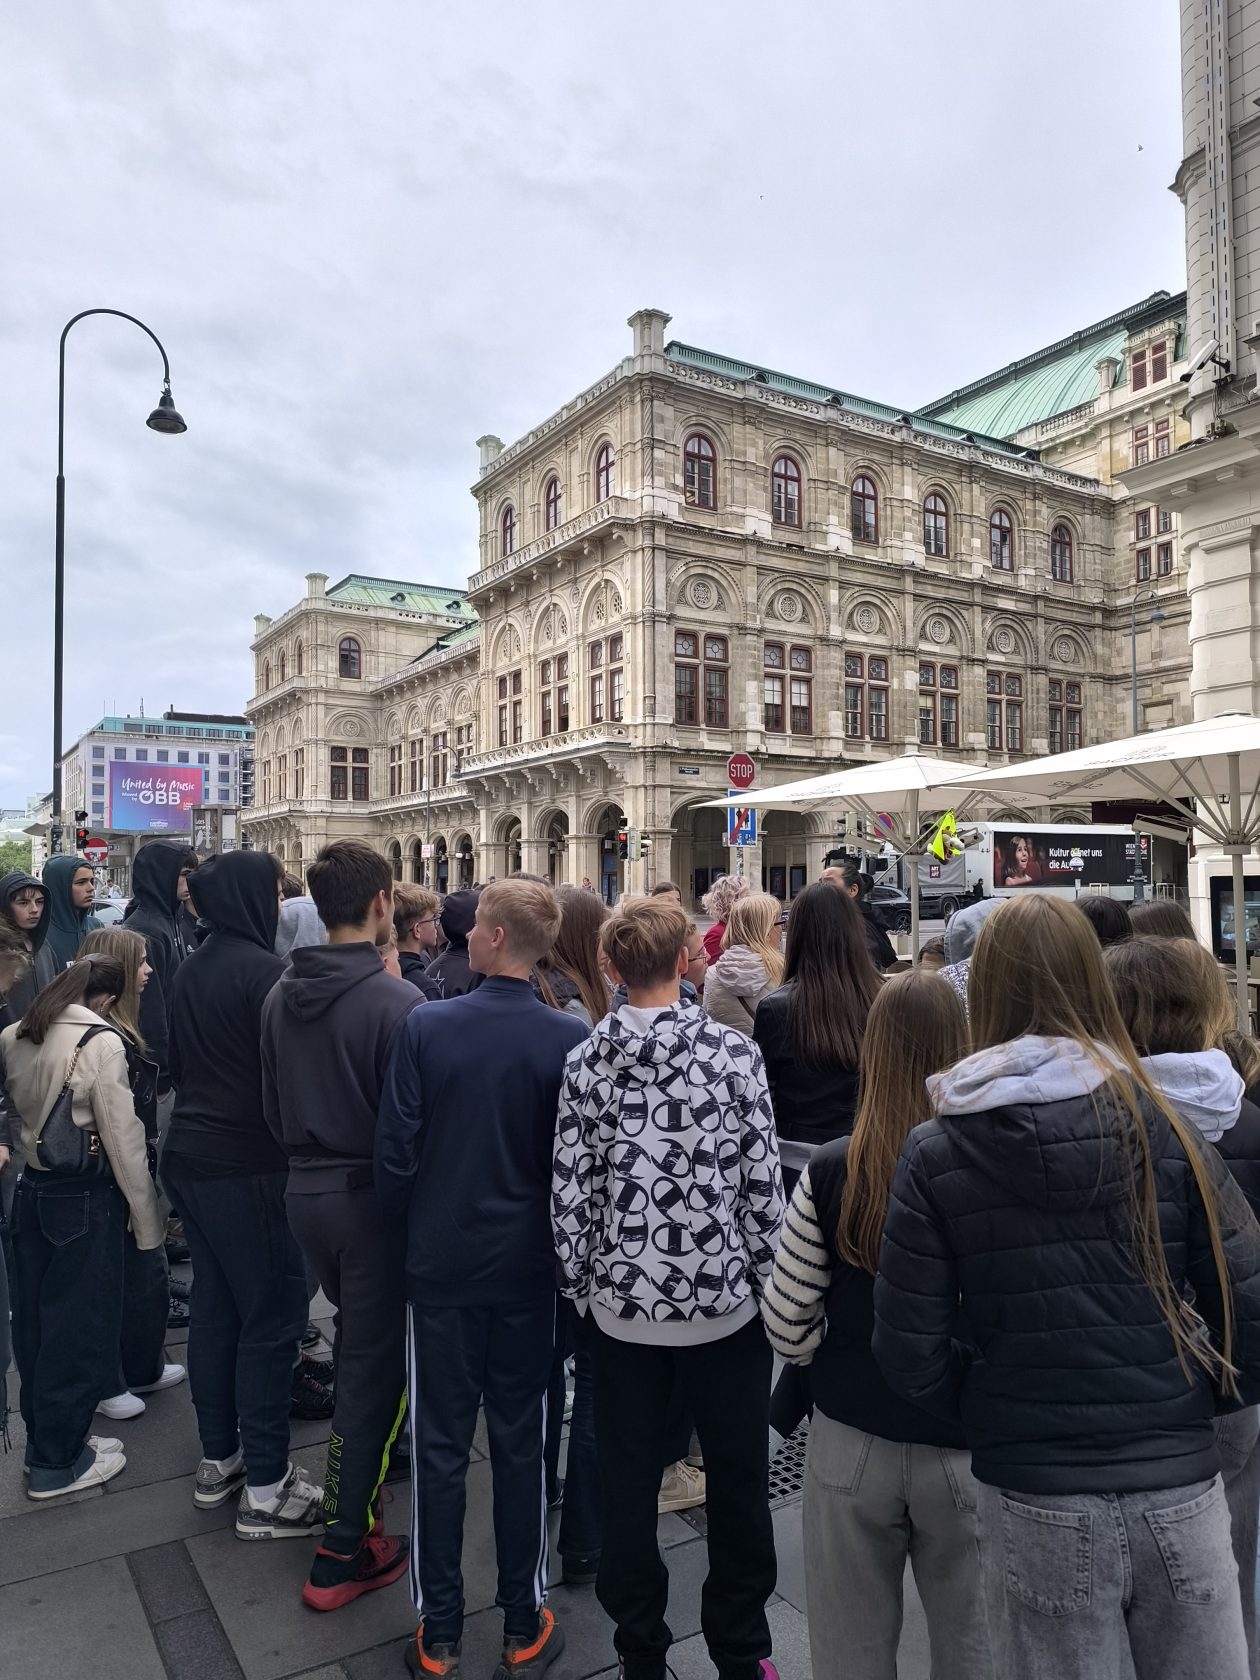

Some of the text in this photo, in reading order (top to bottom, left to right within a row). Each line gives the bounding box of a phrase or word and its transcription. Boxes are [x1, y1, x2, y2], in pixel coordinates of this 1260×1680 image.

[731, 764, 753, 778] STOP
[121, 777, 195, 793] United by Music
[1049, 847, 1069, 857] Kultur
[1091, 849, 1103, 857] uns
[1049, 860, 1060, 869] die
[322, 1430, 344, 1514] NIKE
